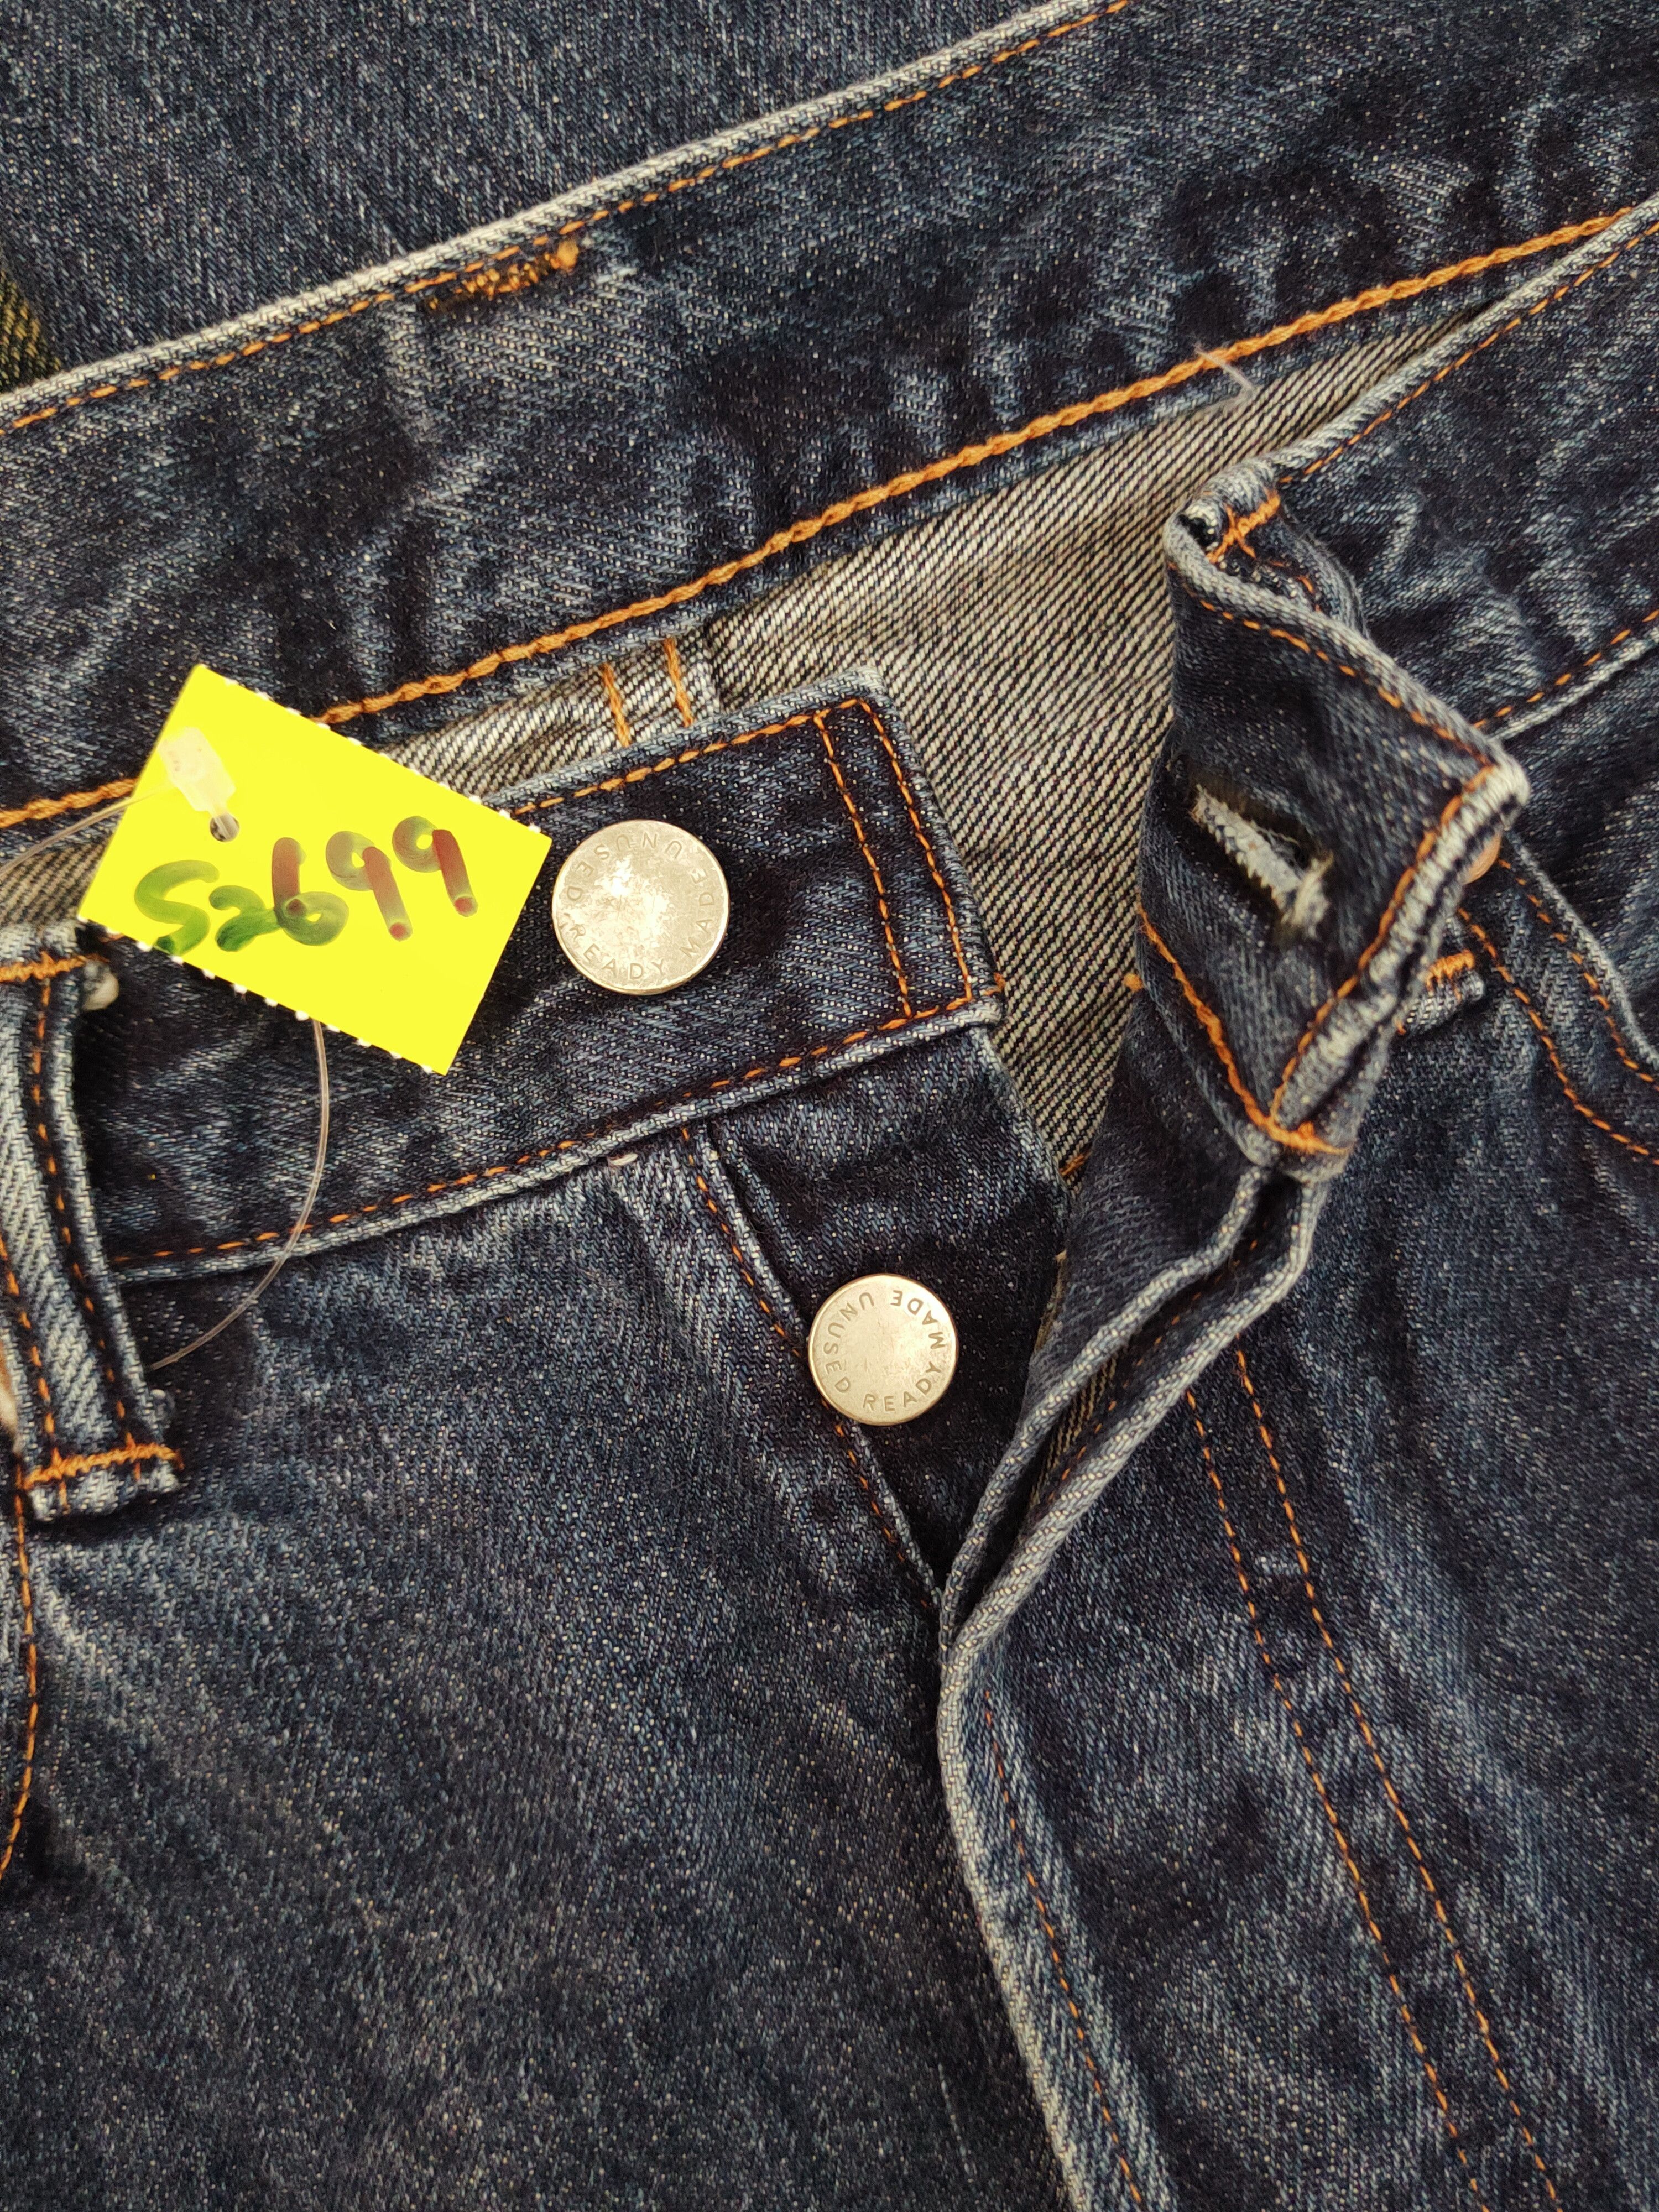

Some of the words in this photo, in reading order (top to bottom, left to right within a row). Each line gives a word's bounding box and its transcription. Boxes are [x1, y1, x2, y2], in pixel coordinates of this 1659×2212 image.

[567, 832, 682, 901] UNUSED
[679, 867, 714, 958] MADE
[569, 924, 666, 980] READY
[823, 1292, 874, 1393] UNUSED
[890, 1290, 945, 1349] MADE
[863, 1361, 941, 1411] READY
